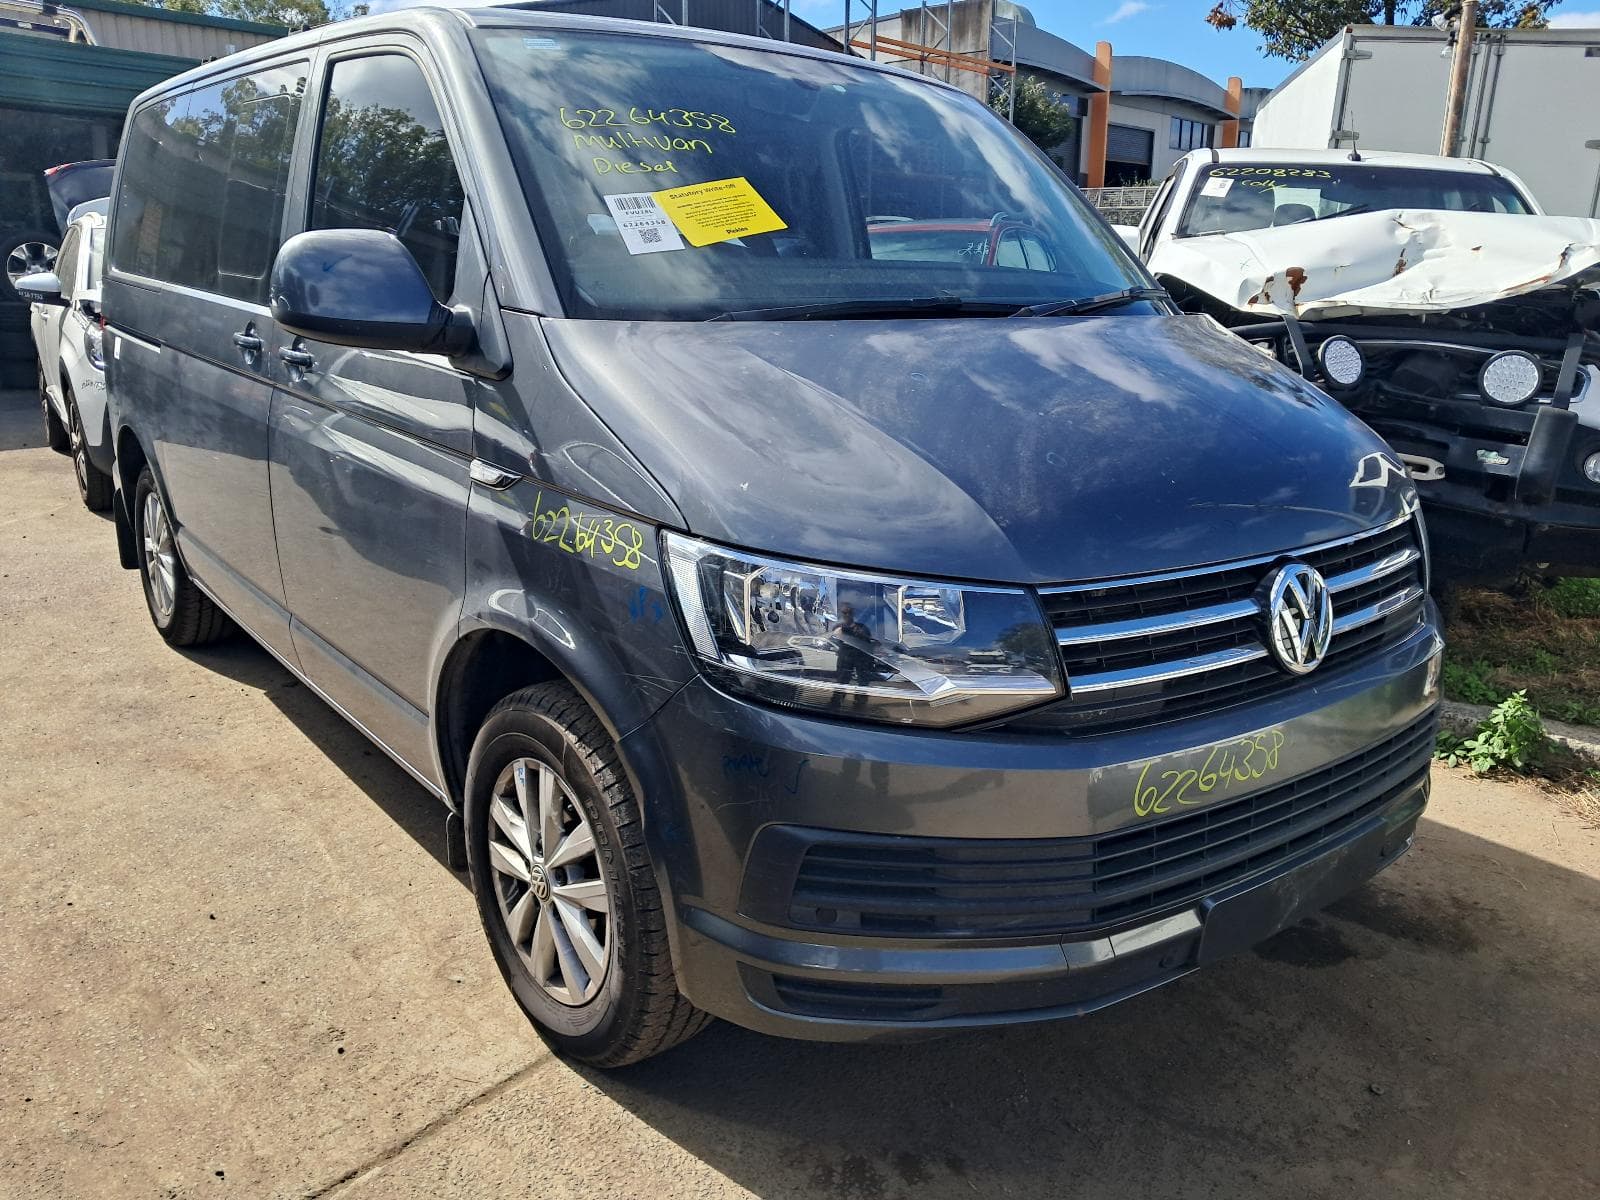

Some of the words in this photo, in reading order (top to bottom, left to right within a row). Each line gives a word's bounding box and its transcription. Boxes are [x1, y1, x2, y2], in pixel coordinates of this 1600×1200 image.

[559, 107, 736, 133] 62264358
[1209, 167, 1332, 179] 62208283
[669, 189, 704, 200] Statutory
[725, 226, 749, 234] Pickles
[532, 491, 643, 570] 62264358
[1134, 729, 1284, 817] 62264358
